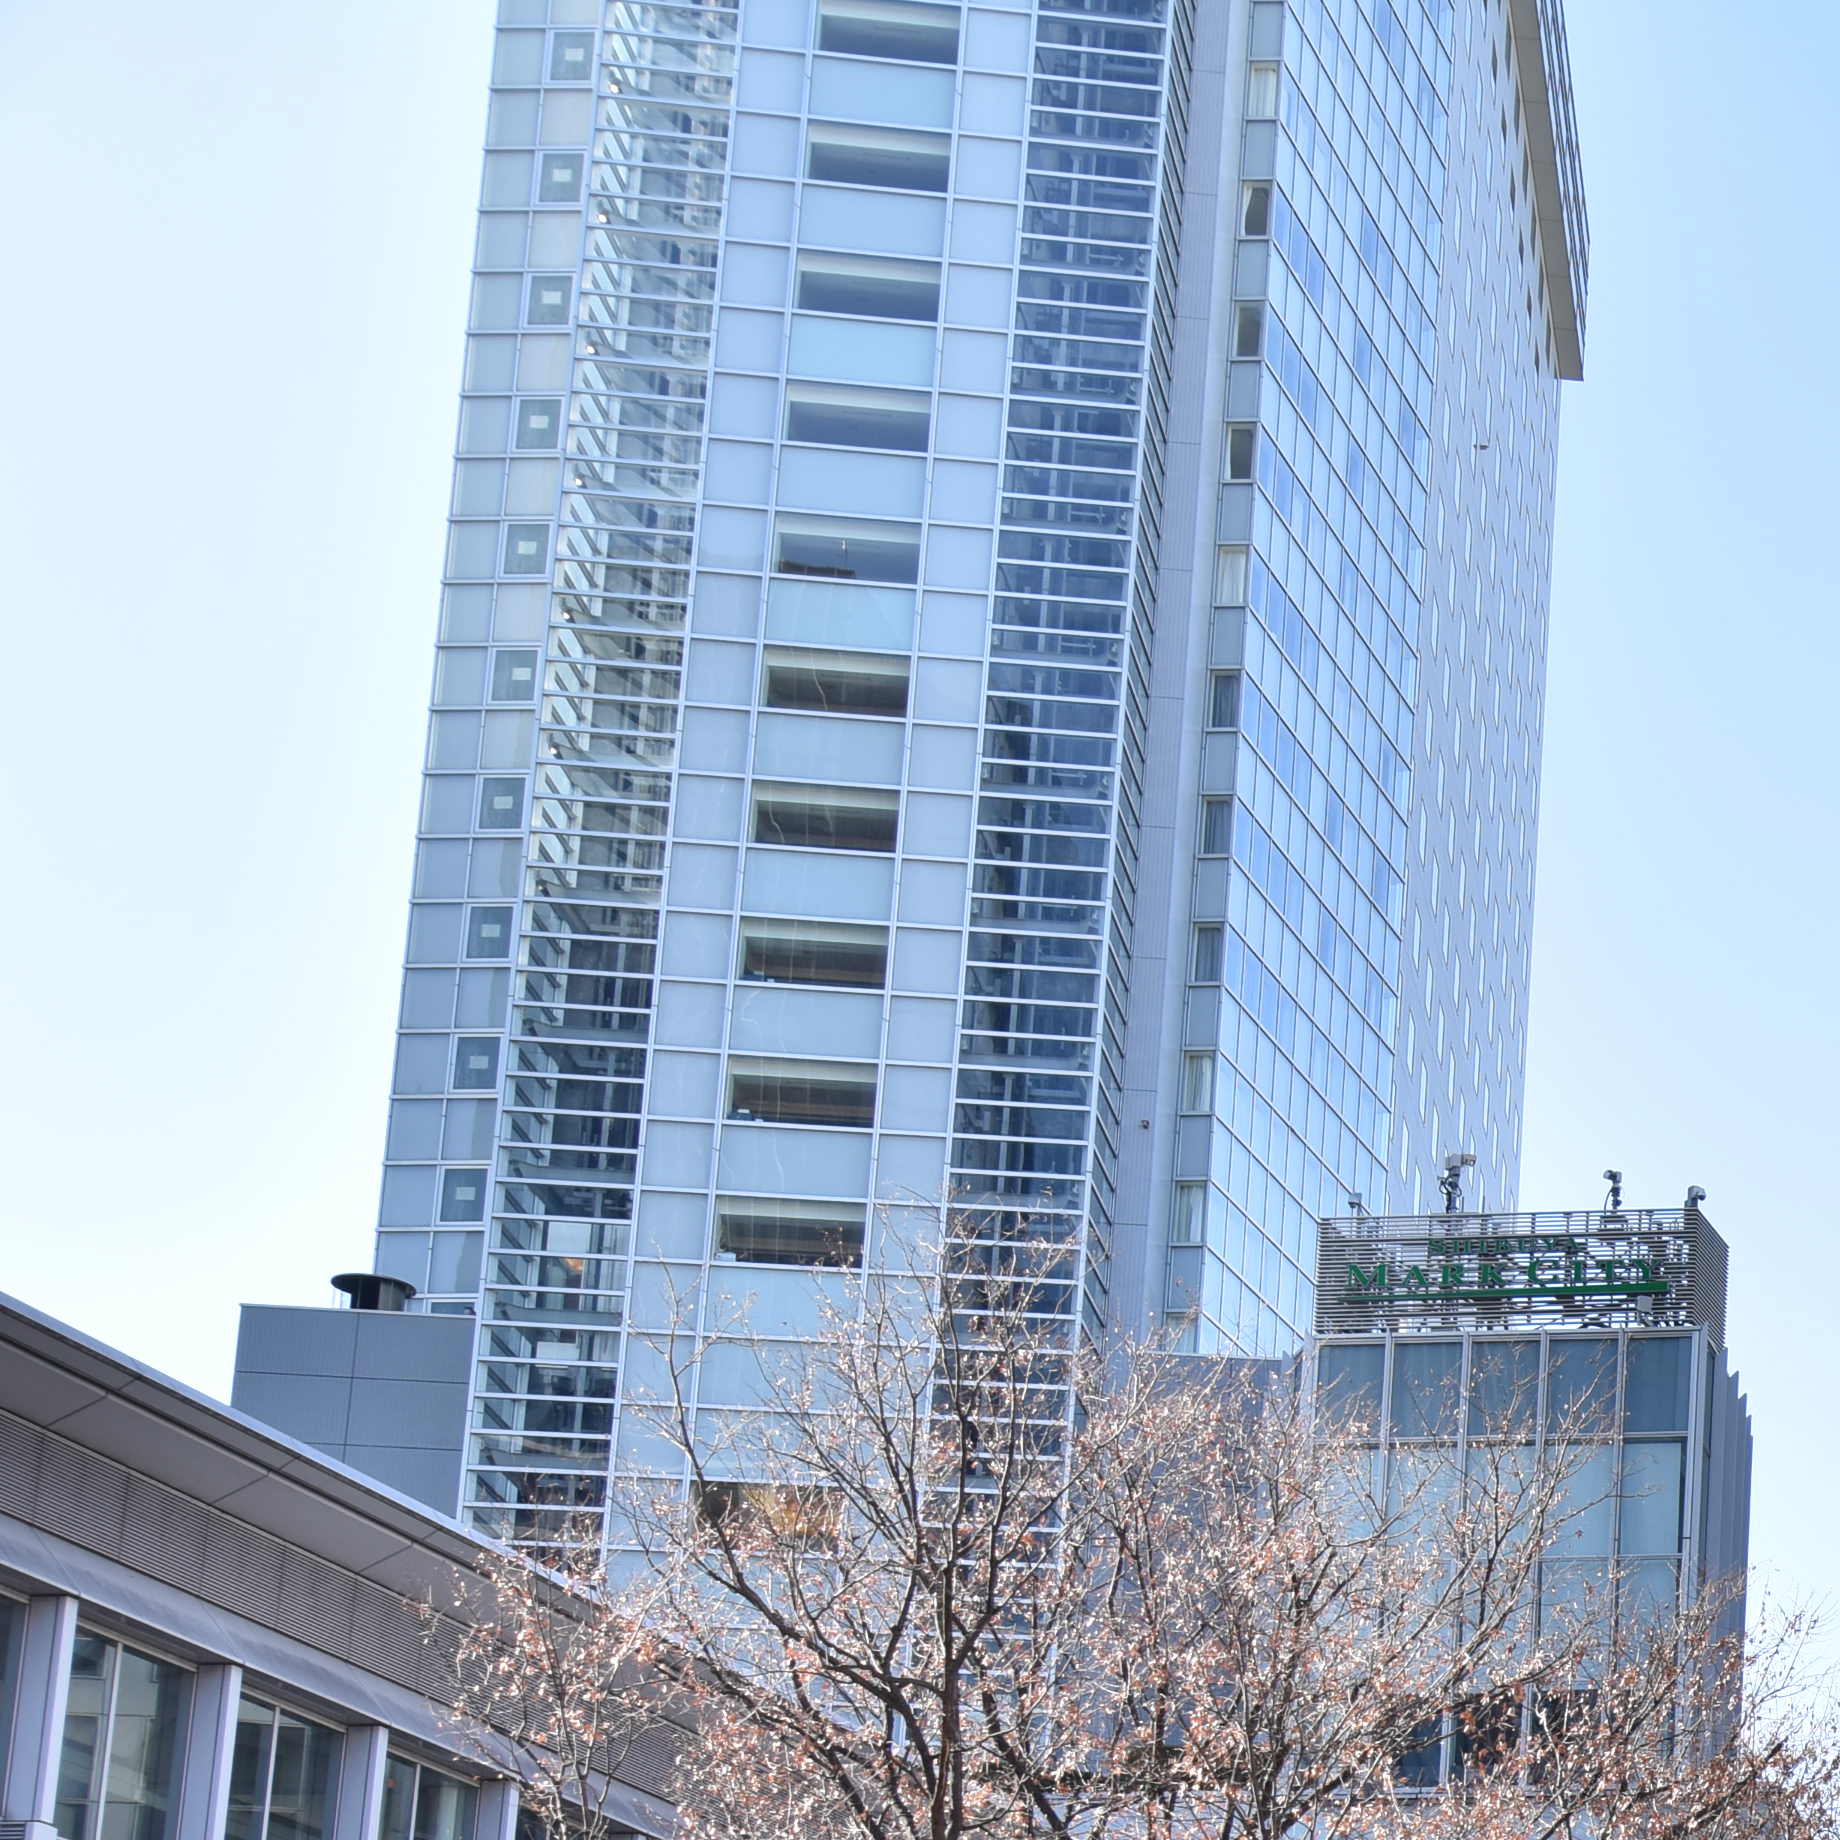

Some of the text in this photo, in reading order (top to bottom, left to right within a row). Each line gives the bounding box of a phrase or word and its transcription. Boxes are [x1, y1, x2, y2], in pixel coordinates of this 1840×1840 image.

[1427, 1236, 1582, 1254] SHIBUYA
[1348, 1258, 1662, 1288] MARK CITY
